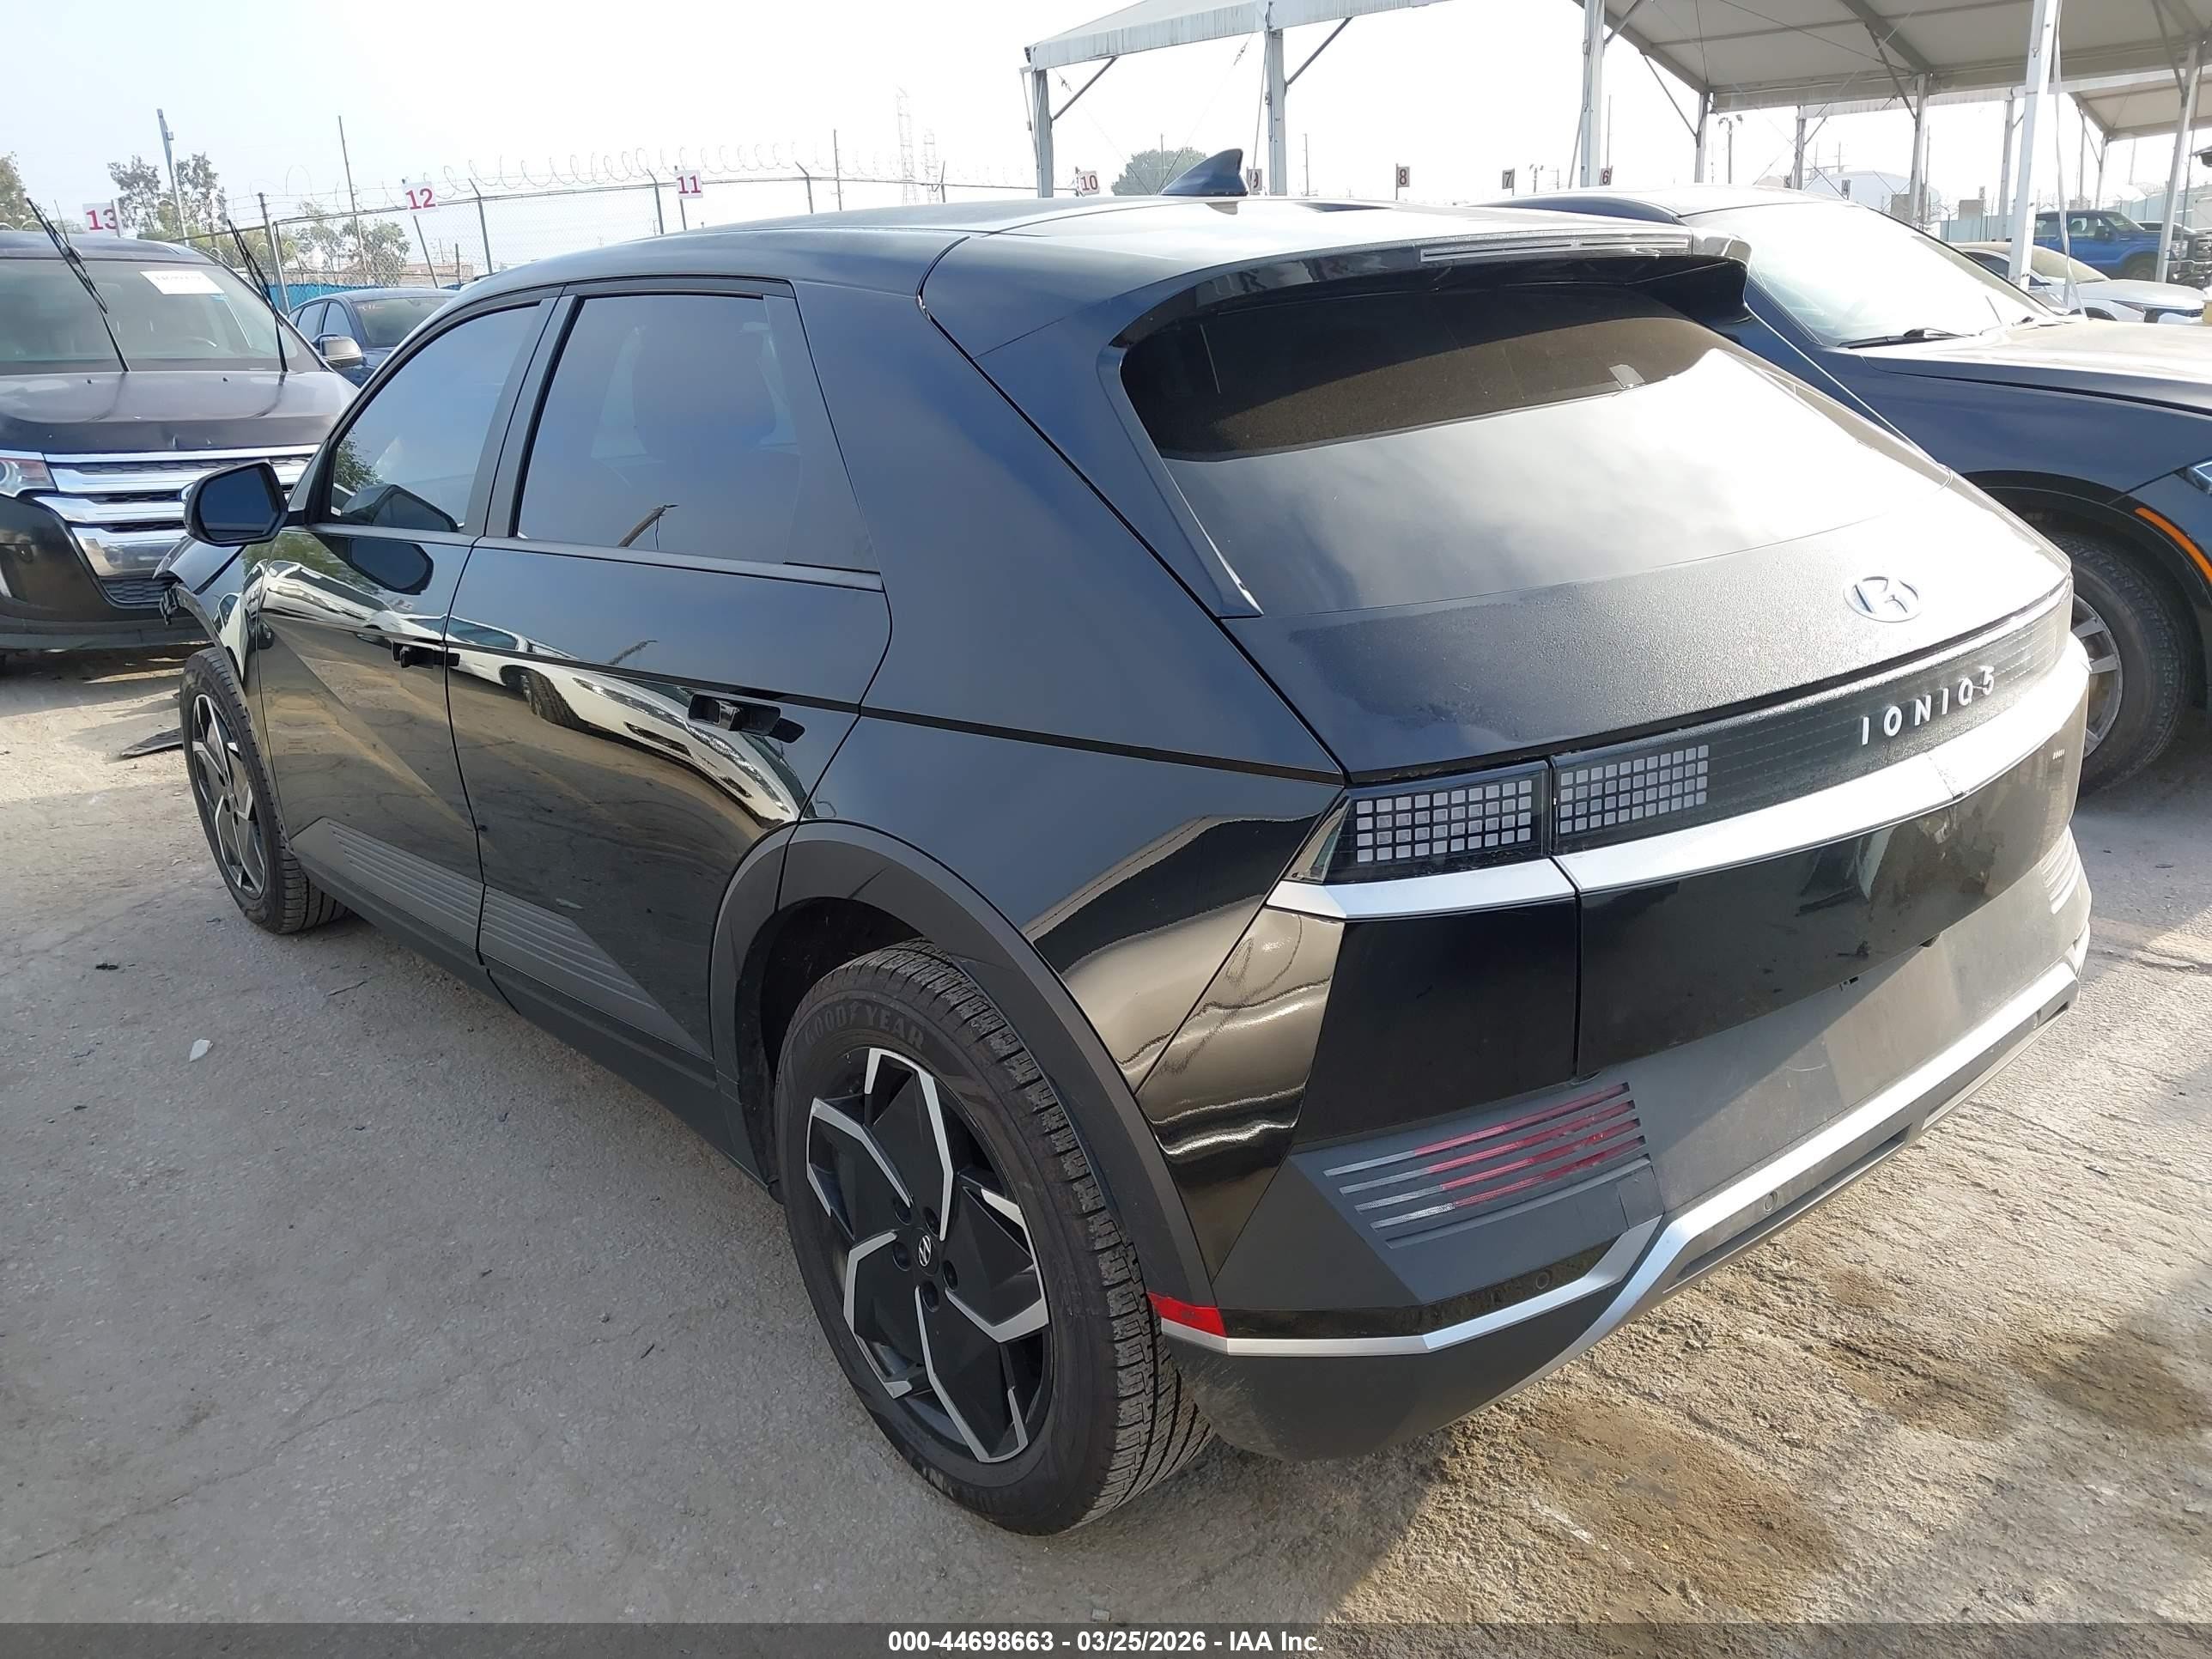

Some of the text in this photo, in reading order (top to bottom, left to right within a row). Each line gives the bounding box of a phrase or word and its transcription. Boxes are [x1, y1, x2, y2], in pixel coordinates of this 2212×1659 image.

[677, 174, 701, 194] 11
[1080, 174, 1098, 191] 10
[1400, 168, 1407, 185] 8
[1504, 171, 1512, 186] 7
[1602, 170, 1609, 185] 6
[405, 188, 435, 210] 12
[86, 208, 118, 230] 13
